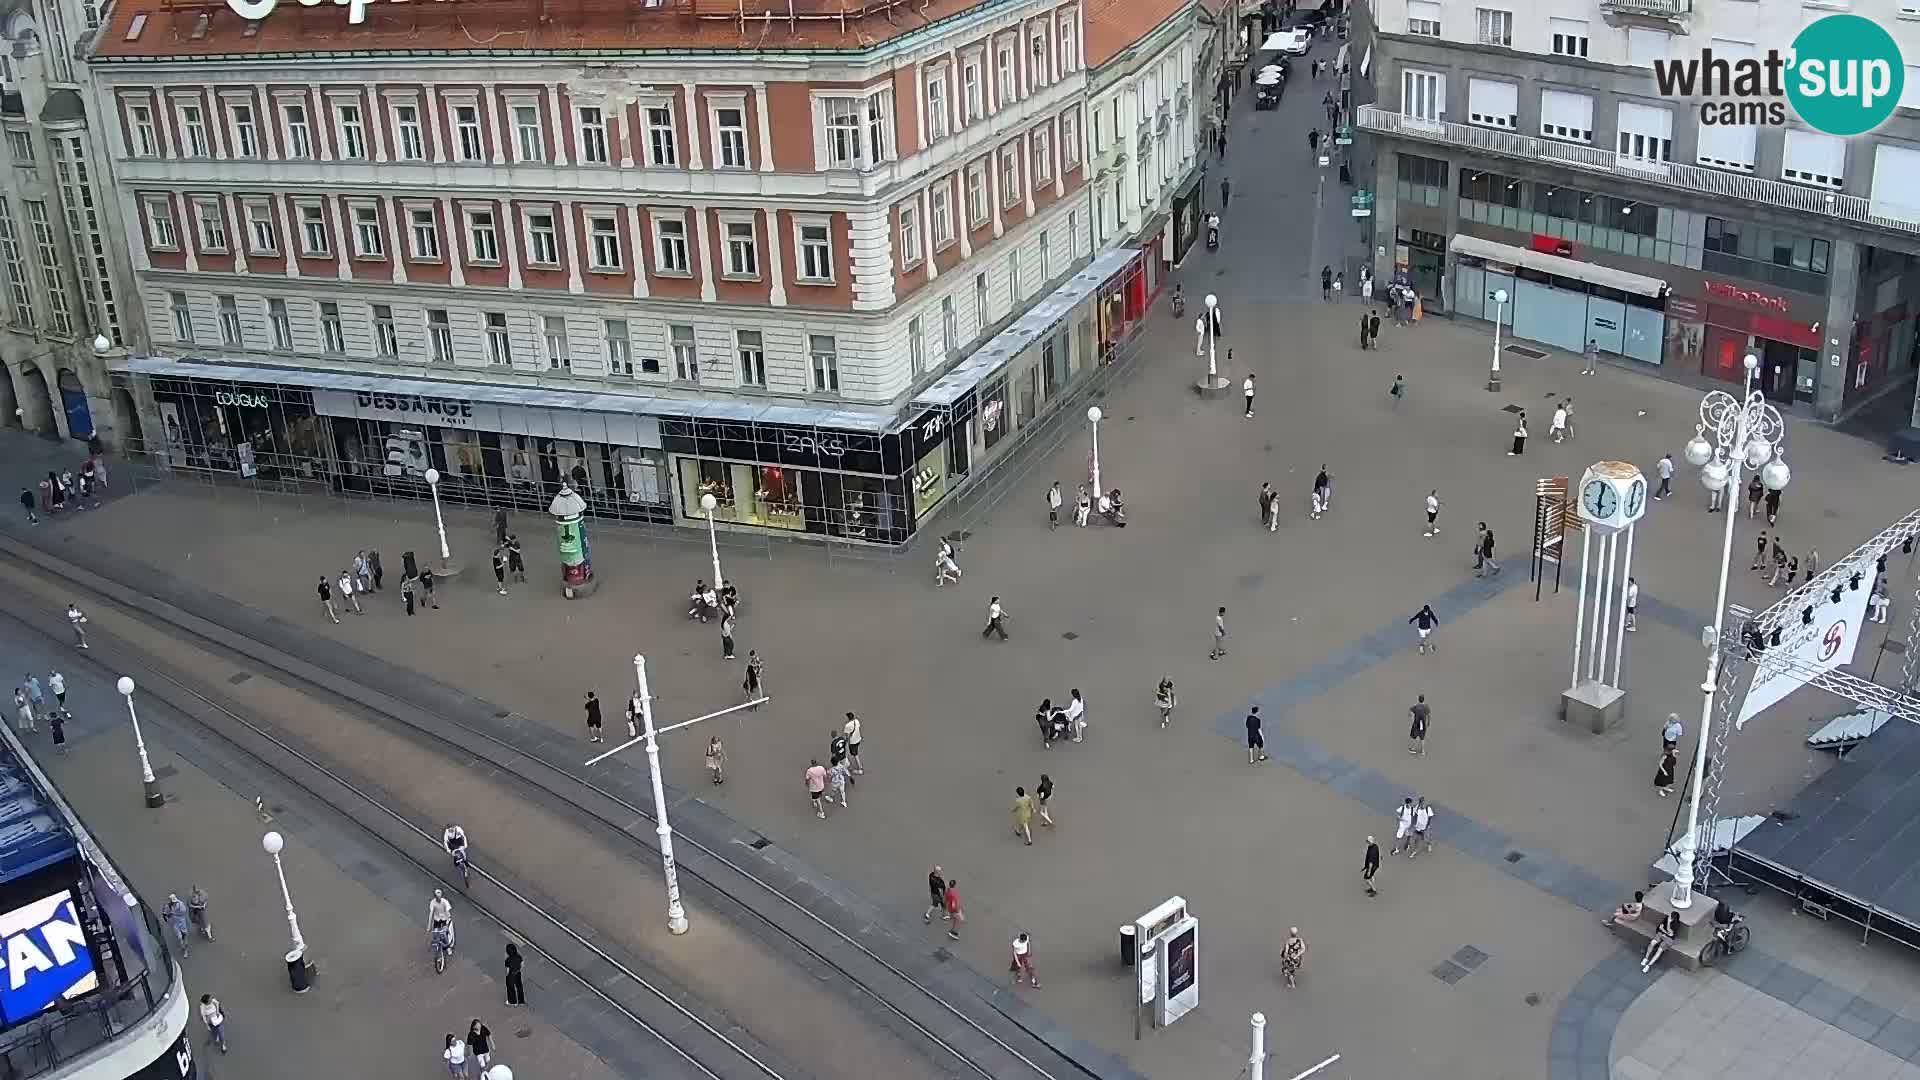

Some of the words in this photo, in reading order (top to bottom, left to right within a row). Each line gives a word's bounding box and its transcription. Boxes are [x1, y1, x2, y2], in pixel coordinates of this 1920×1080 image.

[215, 391, 269, 409] DOUGLAS
[355, 390, 473, 418] DESSANGE
[784, 433, 846, 457] ZAKS
